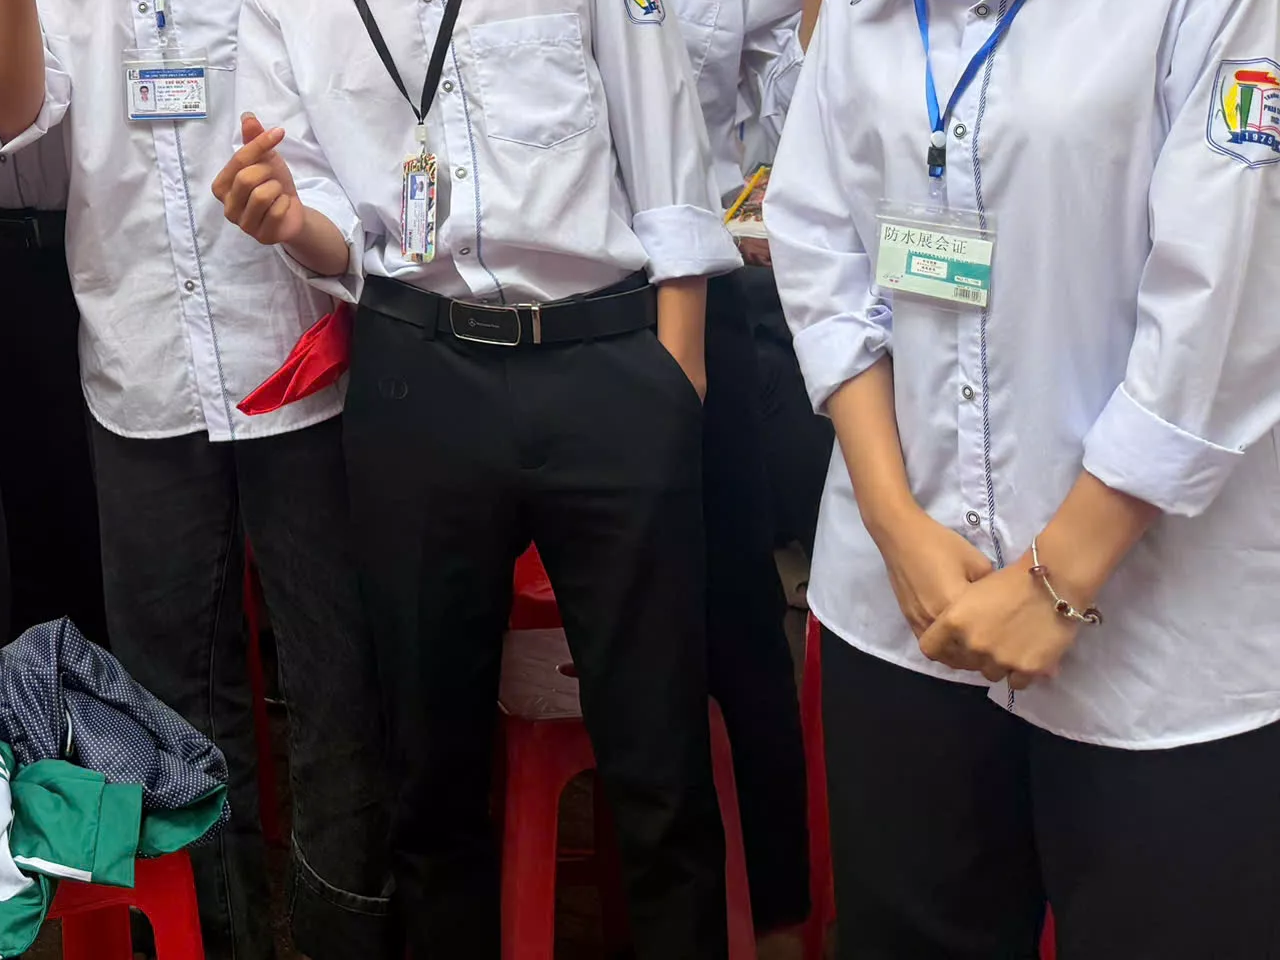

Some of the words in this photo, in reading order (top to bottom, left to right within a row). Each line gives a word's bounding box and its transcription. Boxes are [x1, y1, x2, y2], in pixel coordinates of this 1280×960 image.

[1244, 132, 1274, 145] 1975
[884, 225, 968, 255] 防水展会证
